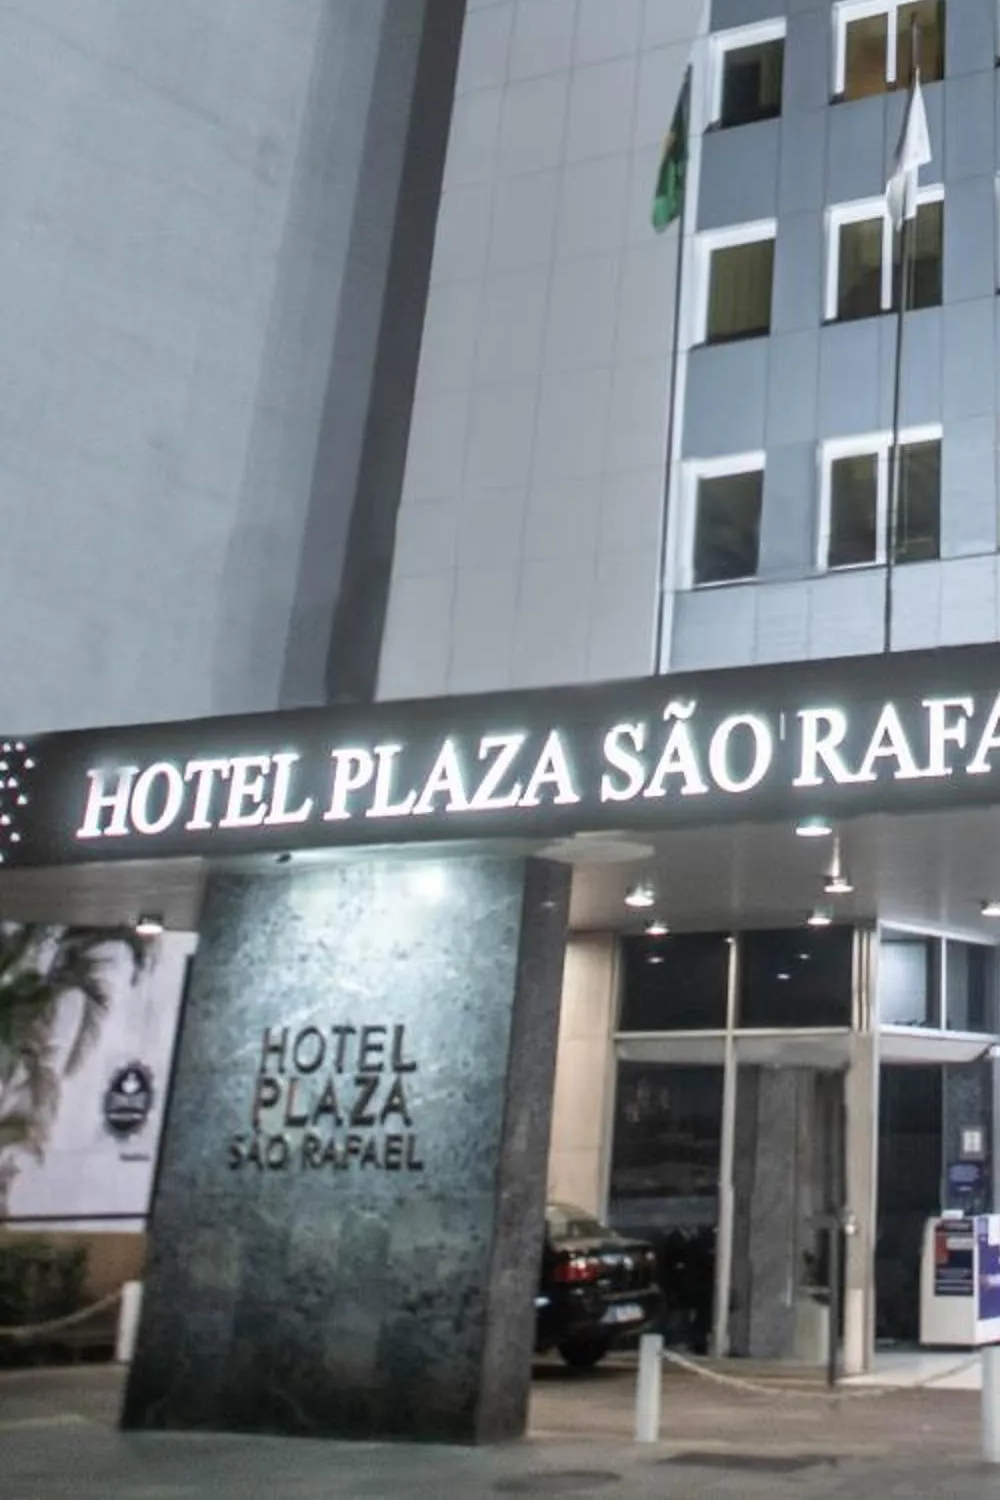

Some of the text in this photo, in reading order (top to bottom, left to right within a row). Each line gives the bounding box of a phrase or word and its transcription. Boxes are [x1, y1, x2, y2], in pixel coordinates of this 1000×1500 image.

[75, 748, 313, 840] HOTEL
[323, 728, 580, 822] PLAZA
[601, 699, 773, 803] SÃO
[261, 1023, 418, 1075] HOTEL
[251, 1073, 413, 1128] PLAZA
[301, 1132, 424, 1171] RAFAEL
